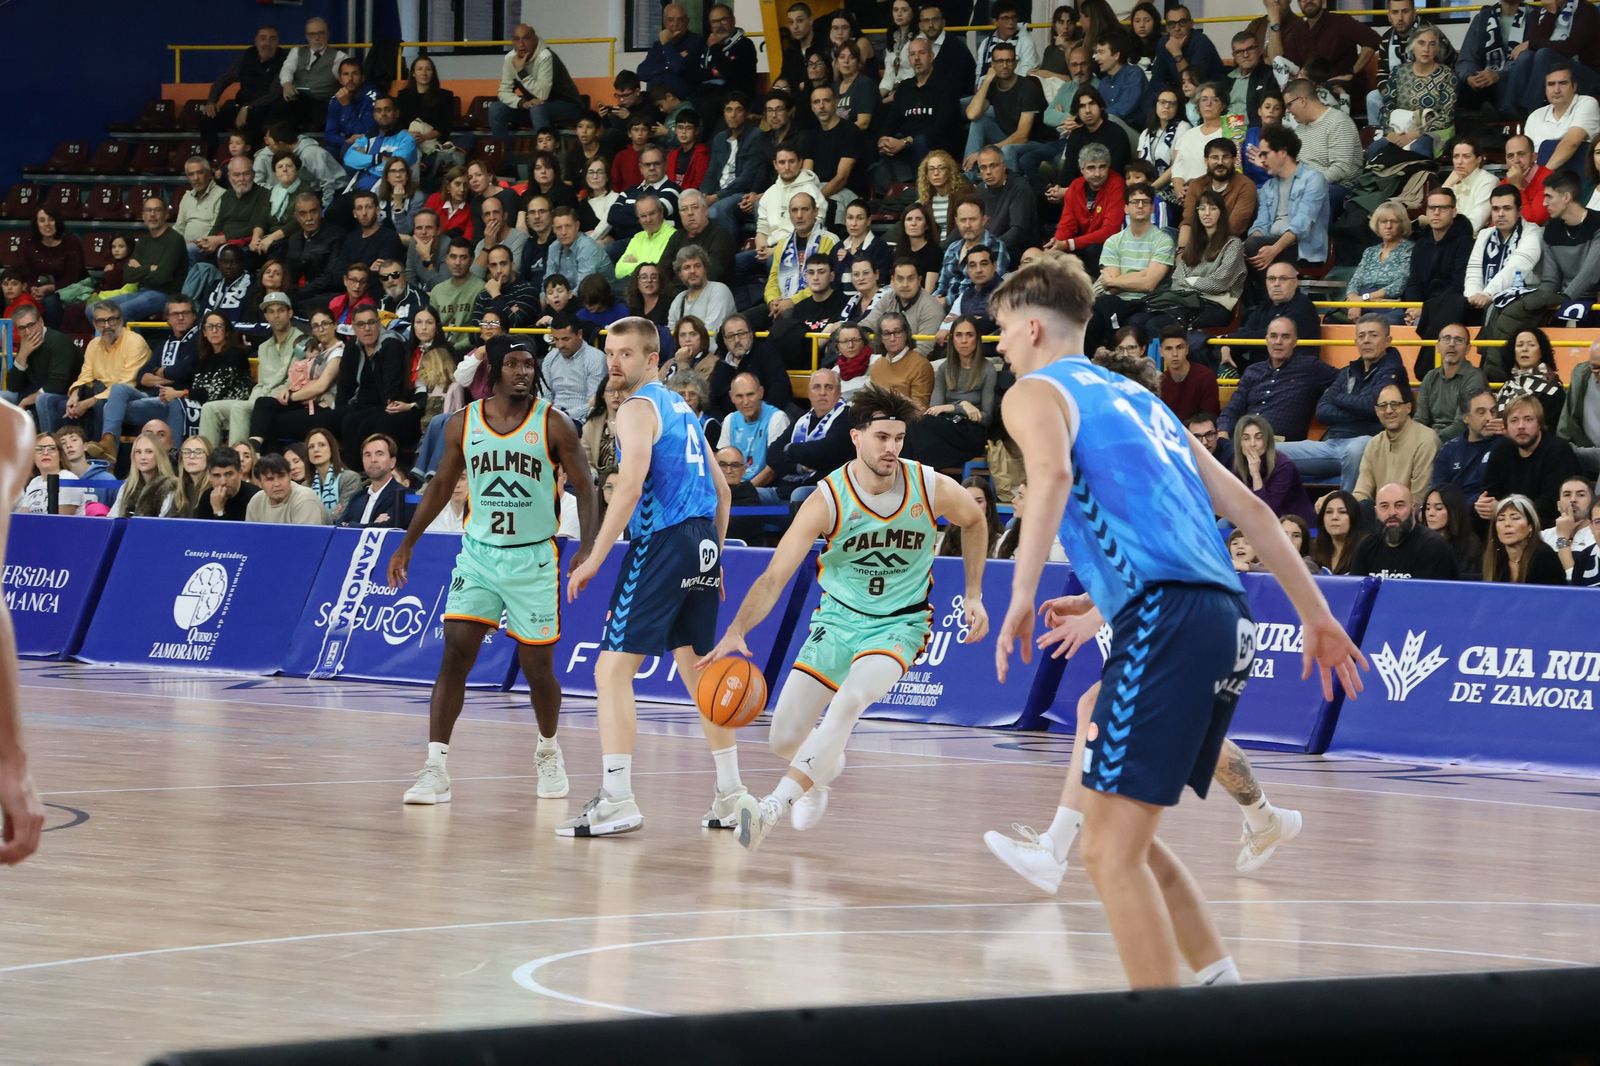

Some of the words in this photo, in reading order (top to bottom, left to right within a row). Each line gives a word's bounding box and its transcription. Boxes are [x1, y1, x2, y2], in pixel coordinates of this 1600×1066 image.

[1113, 398, 1199, 474] 14
[685, 423, 705, 477] 4
[470, 450, 543, 482] PALMER
[480, 500, 533, 508] conectabalear
[491, 511, 516, 535] 21
[842, 528, 926, 552] PALMER
[184, 549, 210, 559] Consejo
[335, 531, 381, 631] ZAMORA
[868, 576, 885, 596] 9
[314, 602, 427, 635] SGUROS
[148, 642, 208, 661] ZAMORANO
[1458, 645, 1536, 680] CAJA
[899, 682, 944, 696] TECNOLOGÍA
[1449, 682, 1486, 704] DE
[1490, 684, 1594, 711] ZAMORA
